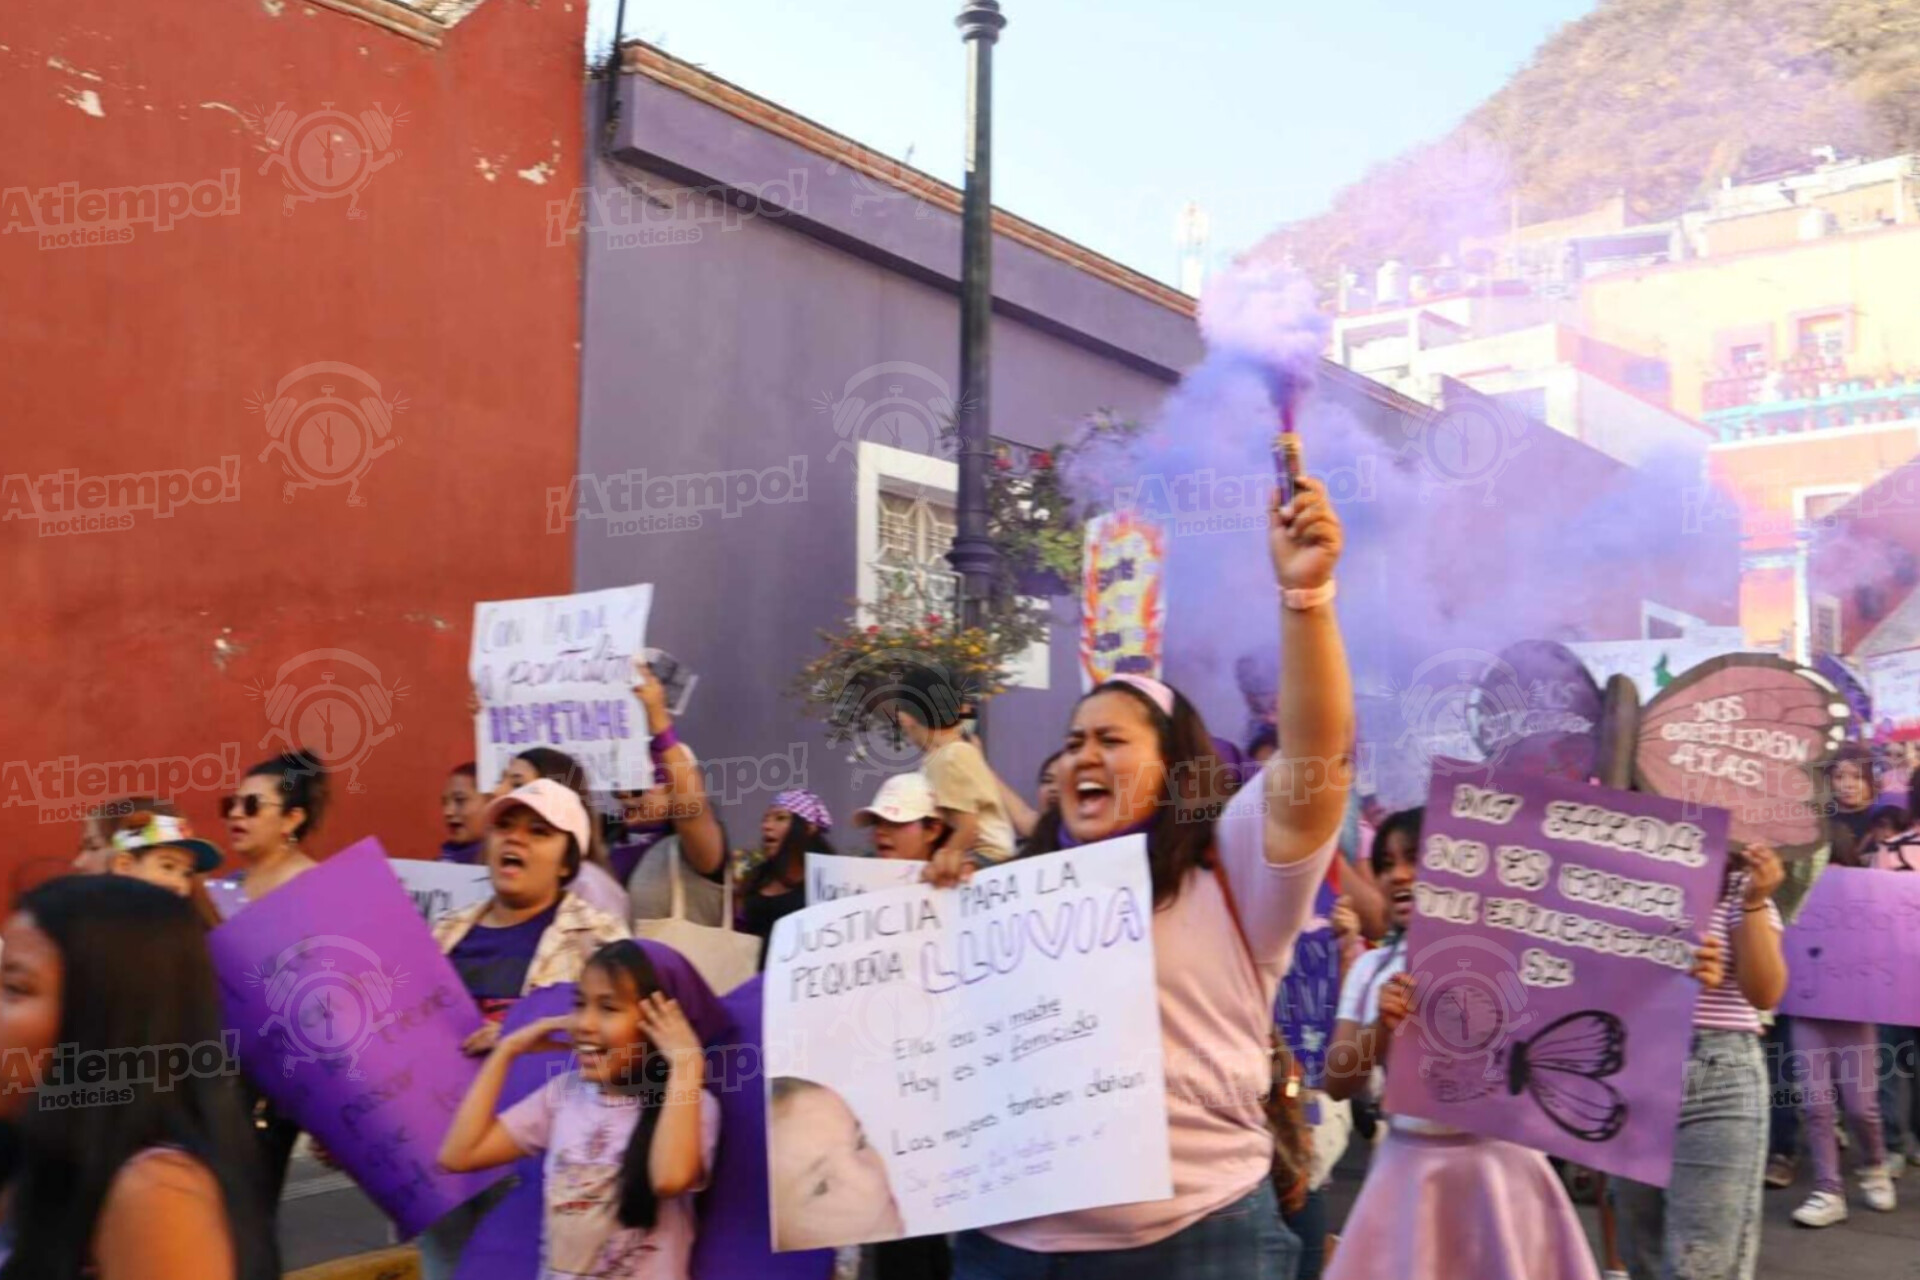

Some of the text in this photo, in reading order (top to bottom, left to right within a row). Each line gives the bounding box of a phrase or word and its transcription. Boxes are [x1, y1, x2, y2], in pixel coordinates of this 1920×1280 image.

[780, 862, 1079, 962] JUSTICIA PARA LA
[921, 887, 1143, 993] LLUVIA
[897, 1071, 940, 1101] Hoy
[891, 1129, 936, 1156] Las
